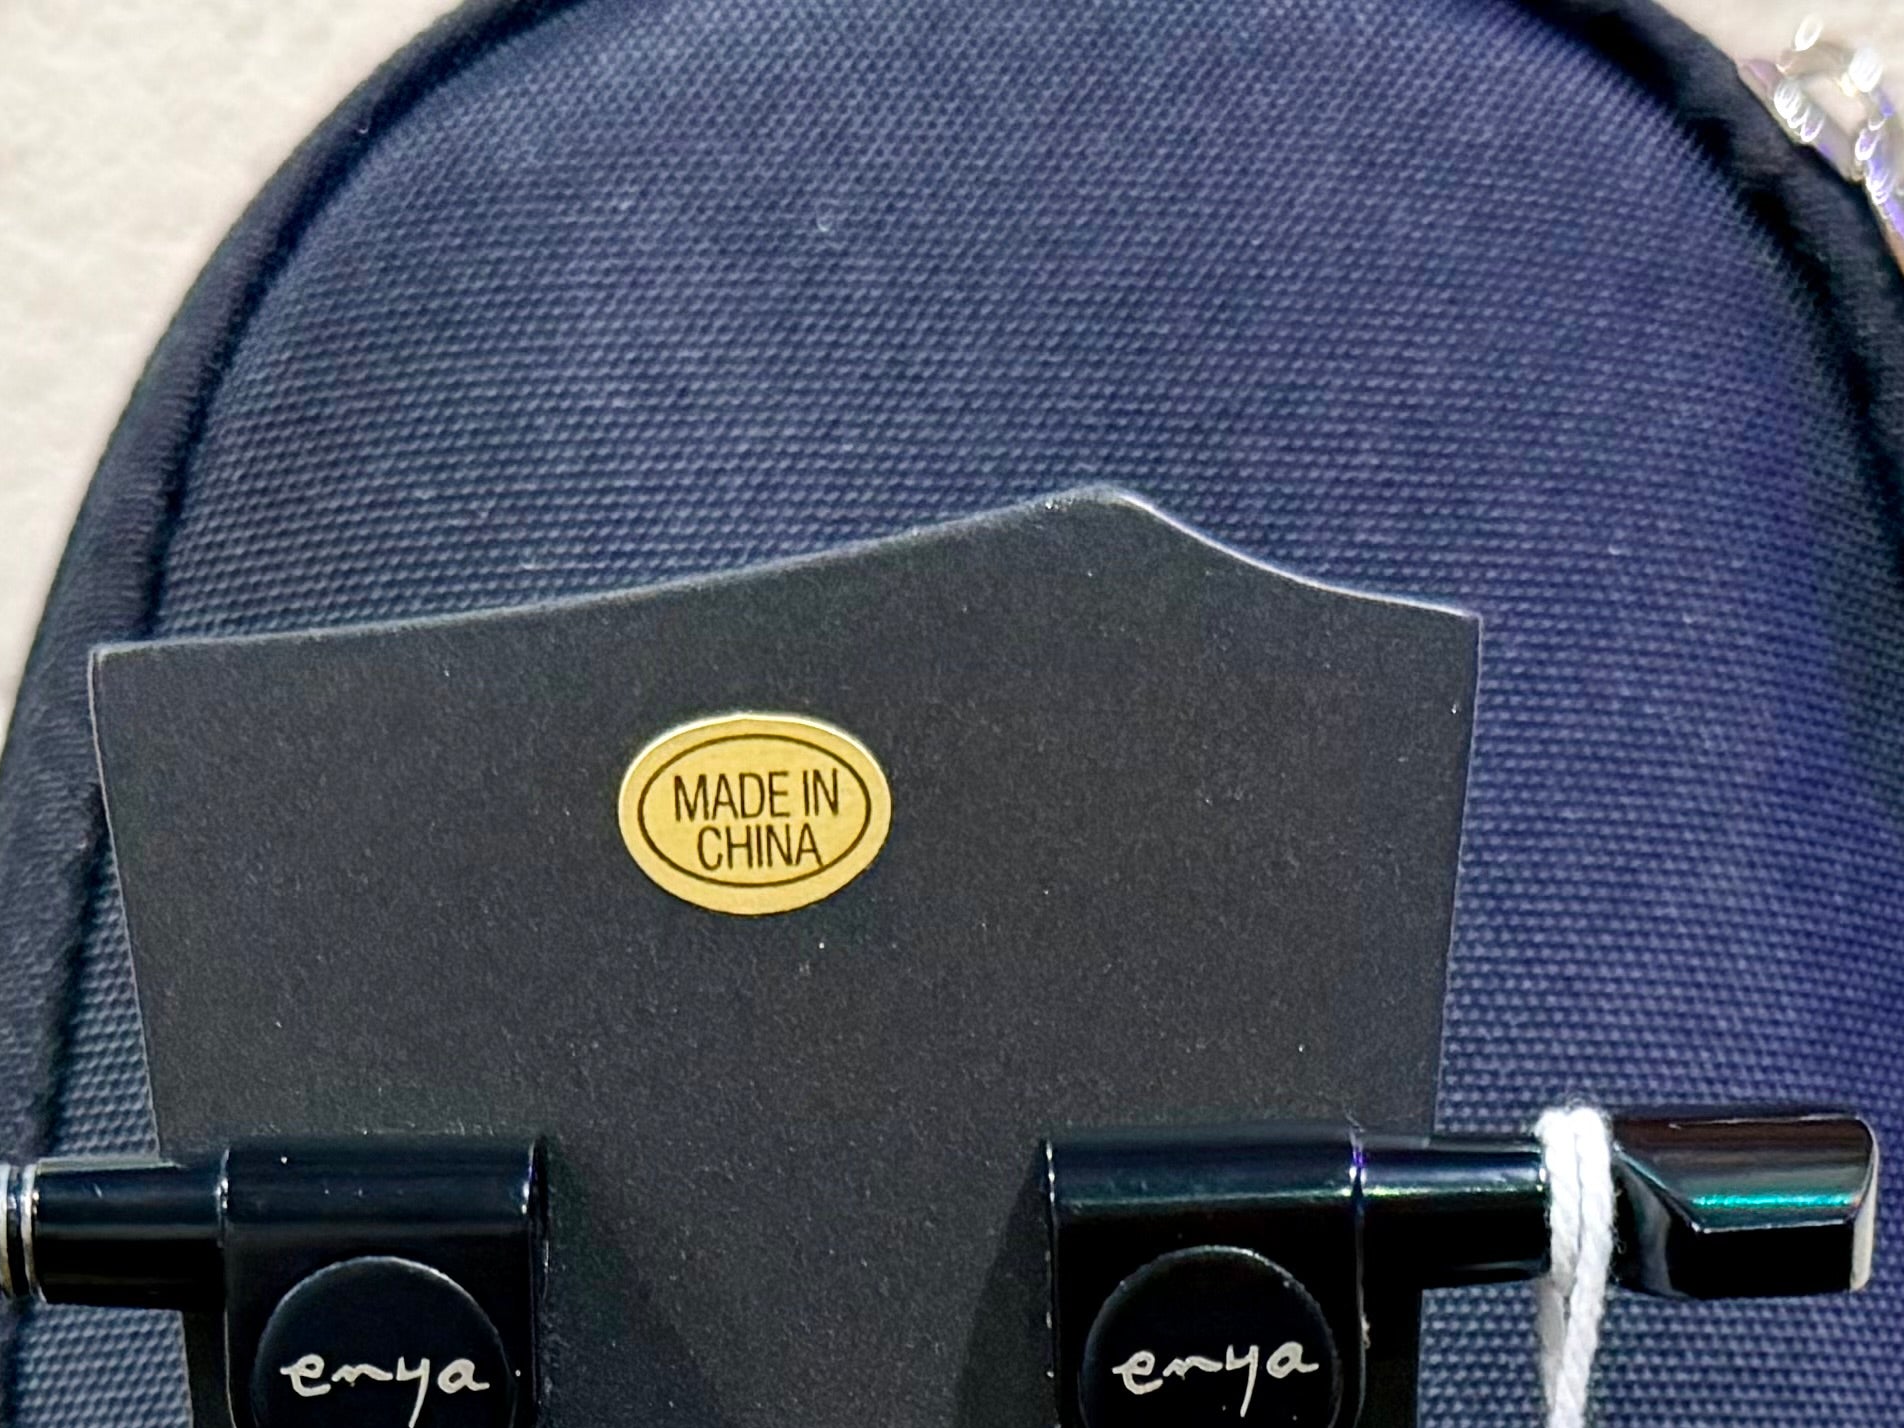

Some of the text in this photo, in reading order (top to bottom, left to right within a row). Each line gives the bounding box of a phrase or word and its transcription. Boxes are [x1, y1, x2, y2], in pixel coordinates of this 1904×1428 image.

[673, 767, 840, 821] MADE IN
[696, 822, 824, 871] CHINA
[1111, 1341, 1321, 1418] enya
